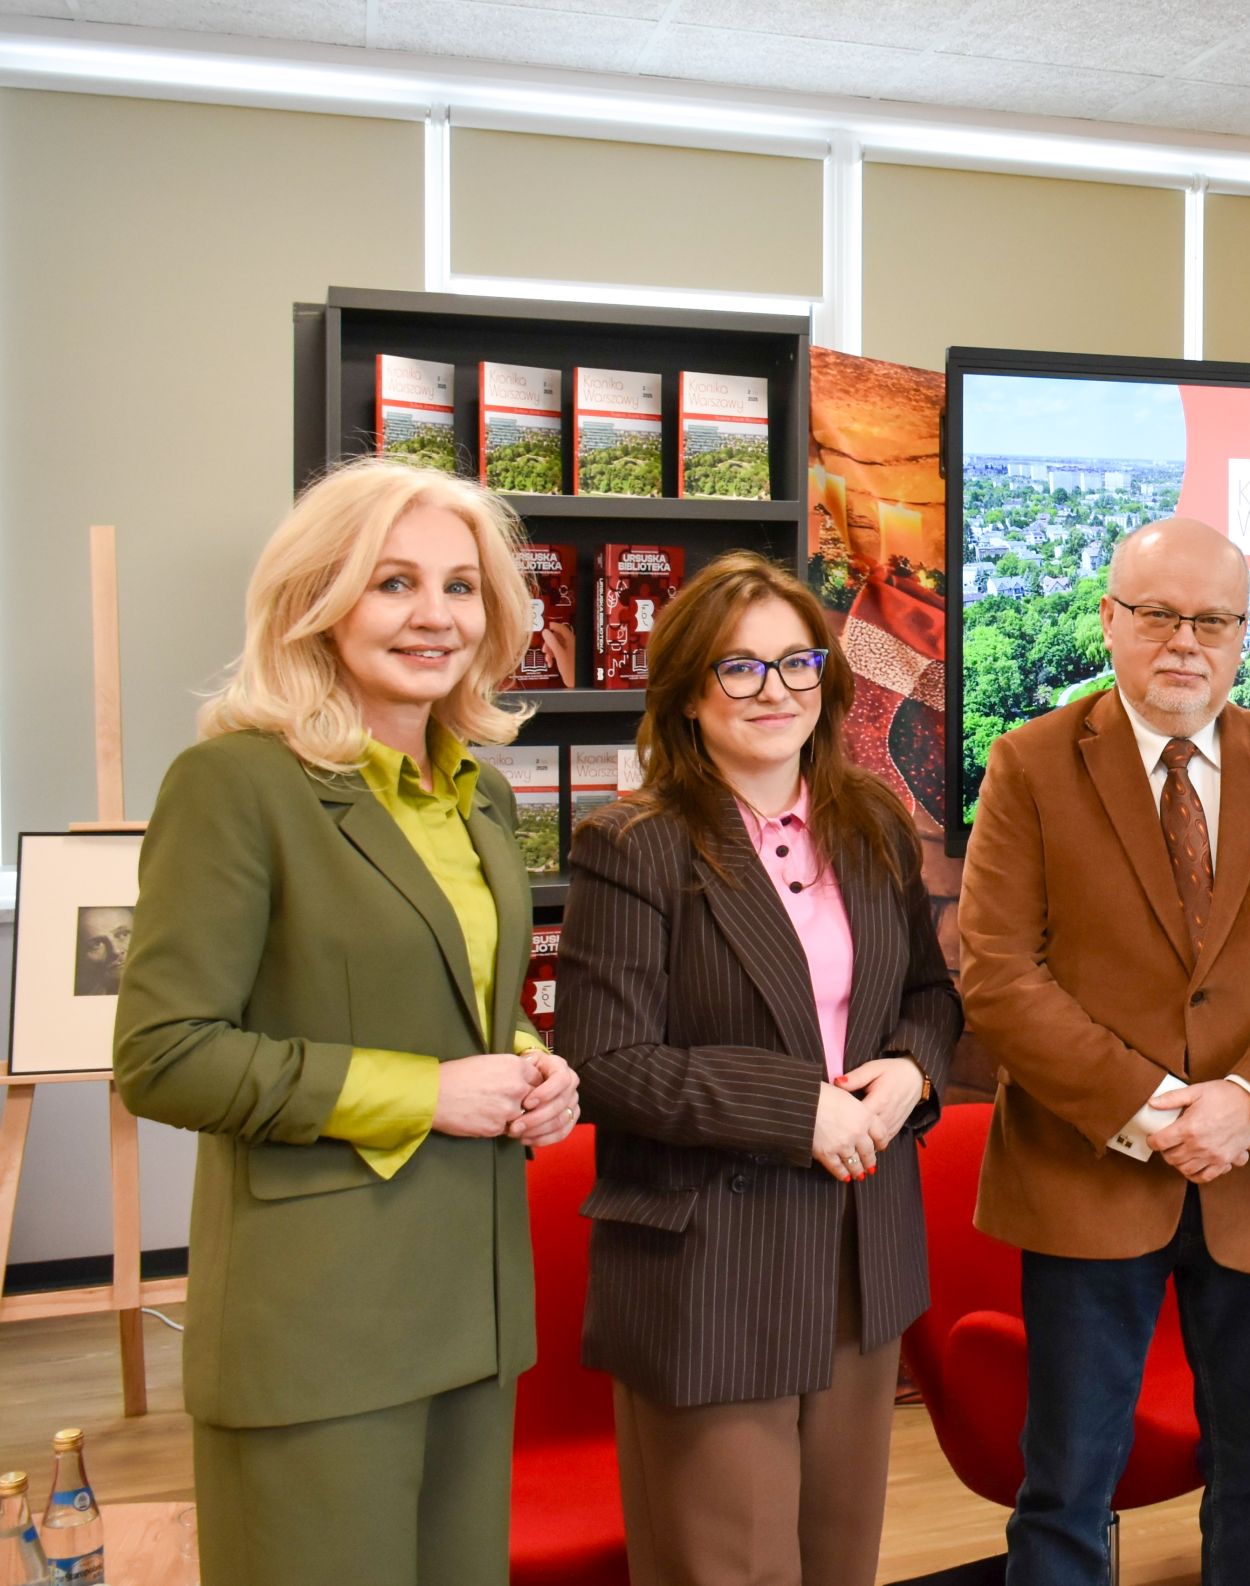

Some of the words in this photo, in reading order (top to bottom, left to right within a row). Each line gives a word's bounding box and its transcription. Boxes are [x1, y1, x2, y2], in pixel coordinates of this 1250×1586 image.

[489, 371, 528, 387] Kronika
[583, 375, 624, 391] Kronika
[489, 383, 540, 405] Warszawy
[688, 381, 728, 395] Kronika
[583, 389, 640, 410] Warszawy
[688, 392, 744, 414] Warszawy
[622, 553, 666, 562] URSUSKA
[617, 562, 671, 572] BIBLIOTEKA
